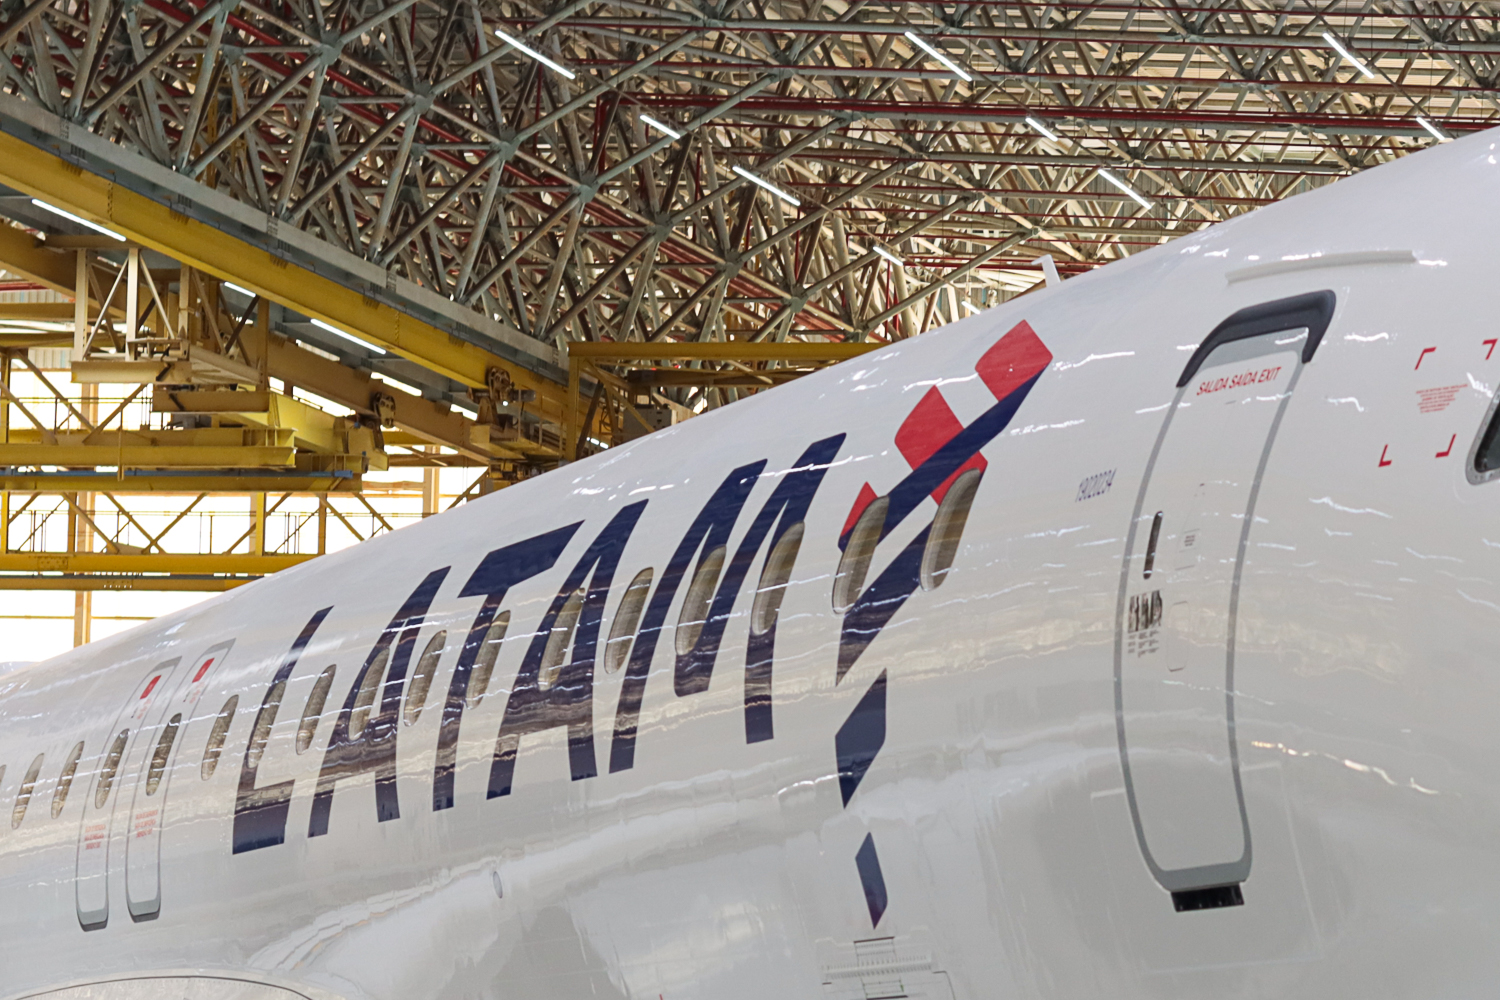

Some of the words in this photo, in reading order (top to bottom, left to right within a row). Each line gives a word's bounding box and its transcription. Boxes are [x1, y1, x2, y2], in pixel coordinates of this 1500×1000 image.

[1196, 376, 1230, 396] SALIDA
[1228, 368, 1259, 389] SAÍDA
[1257, 366, 1282, 384] EXIT
[232, 432, 848, 855] LATAM
